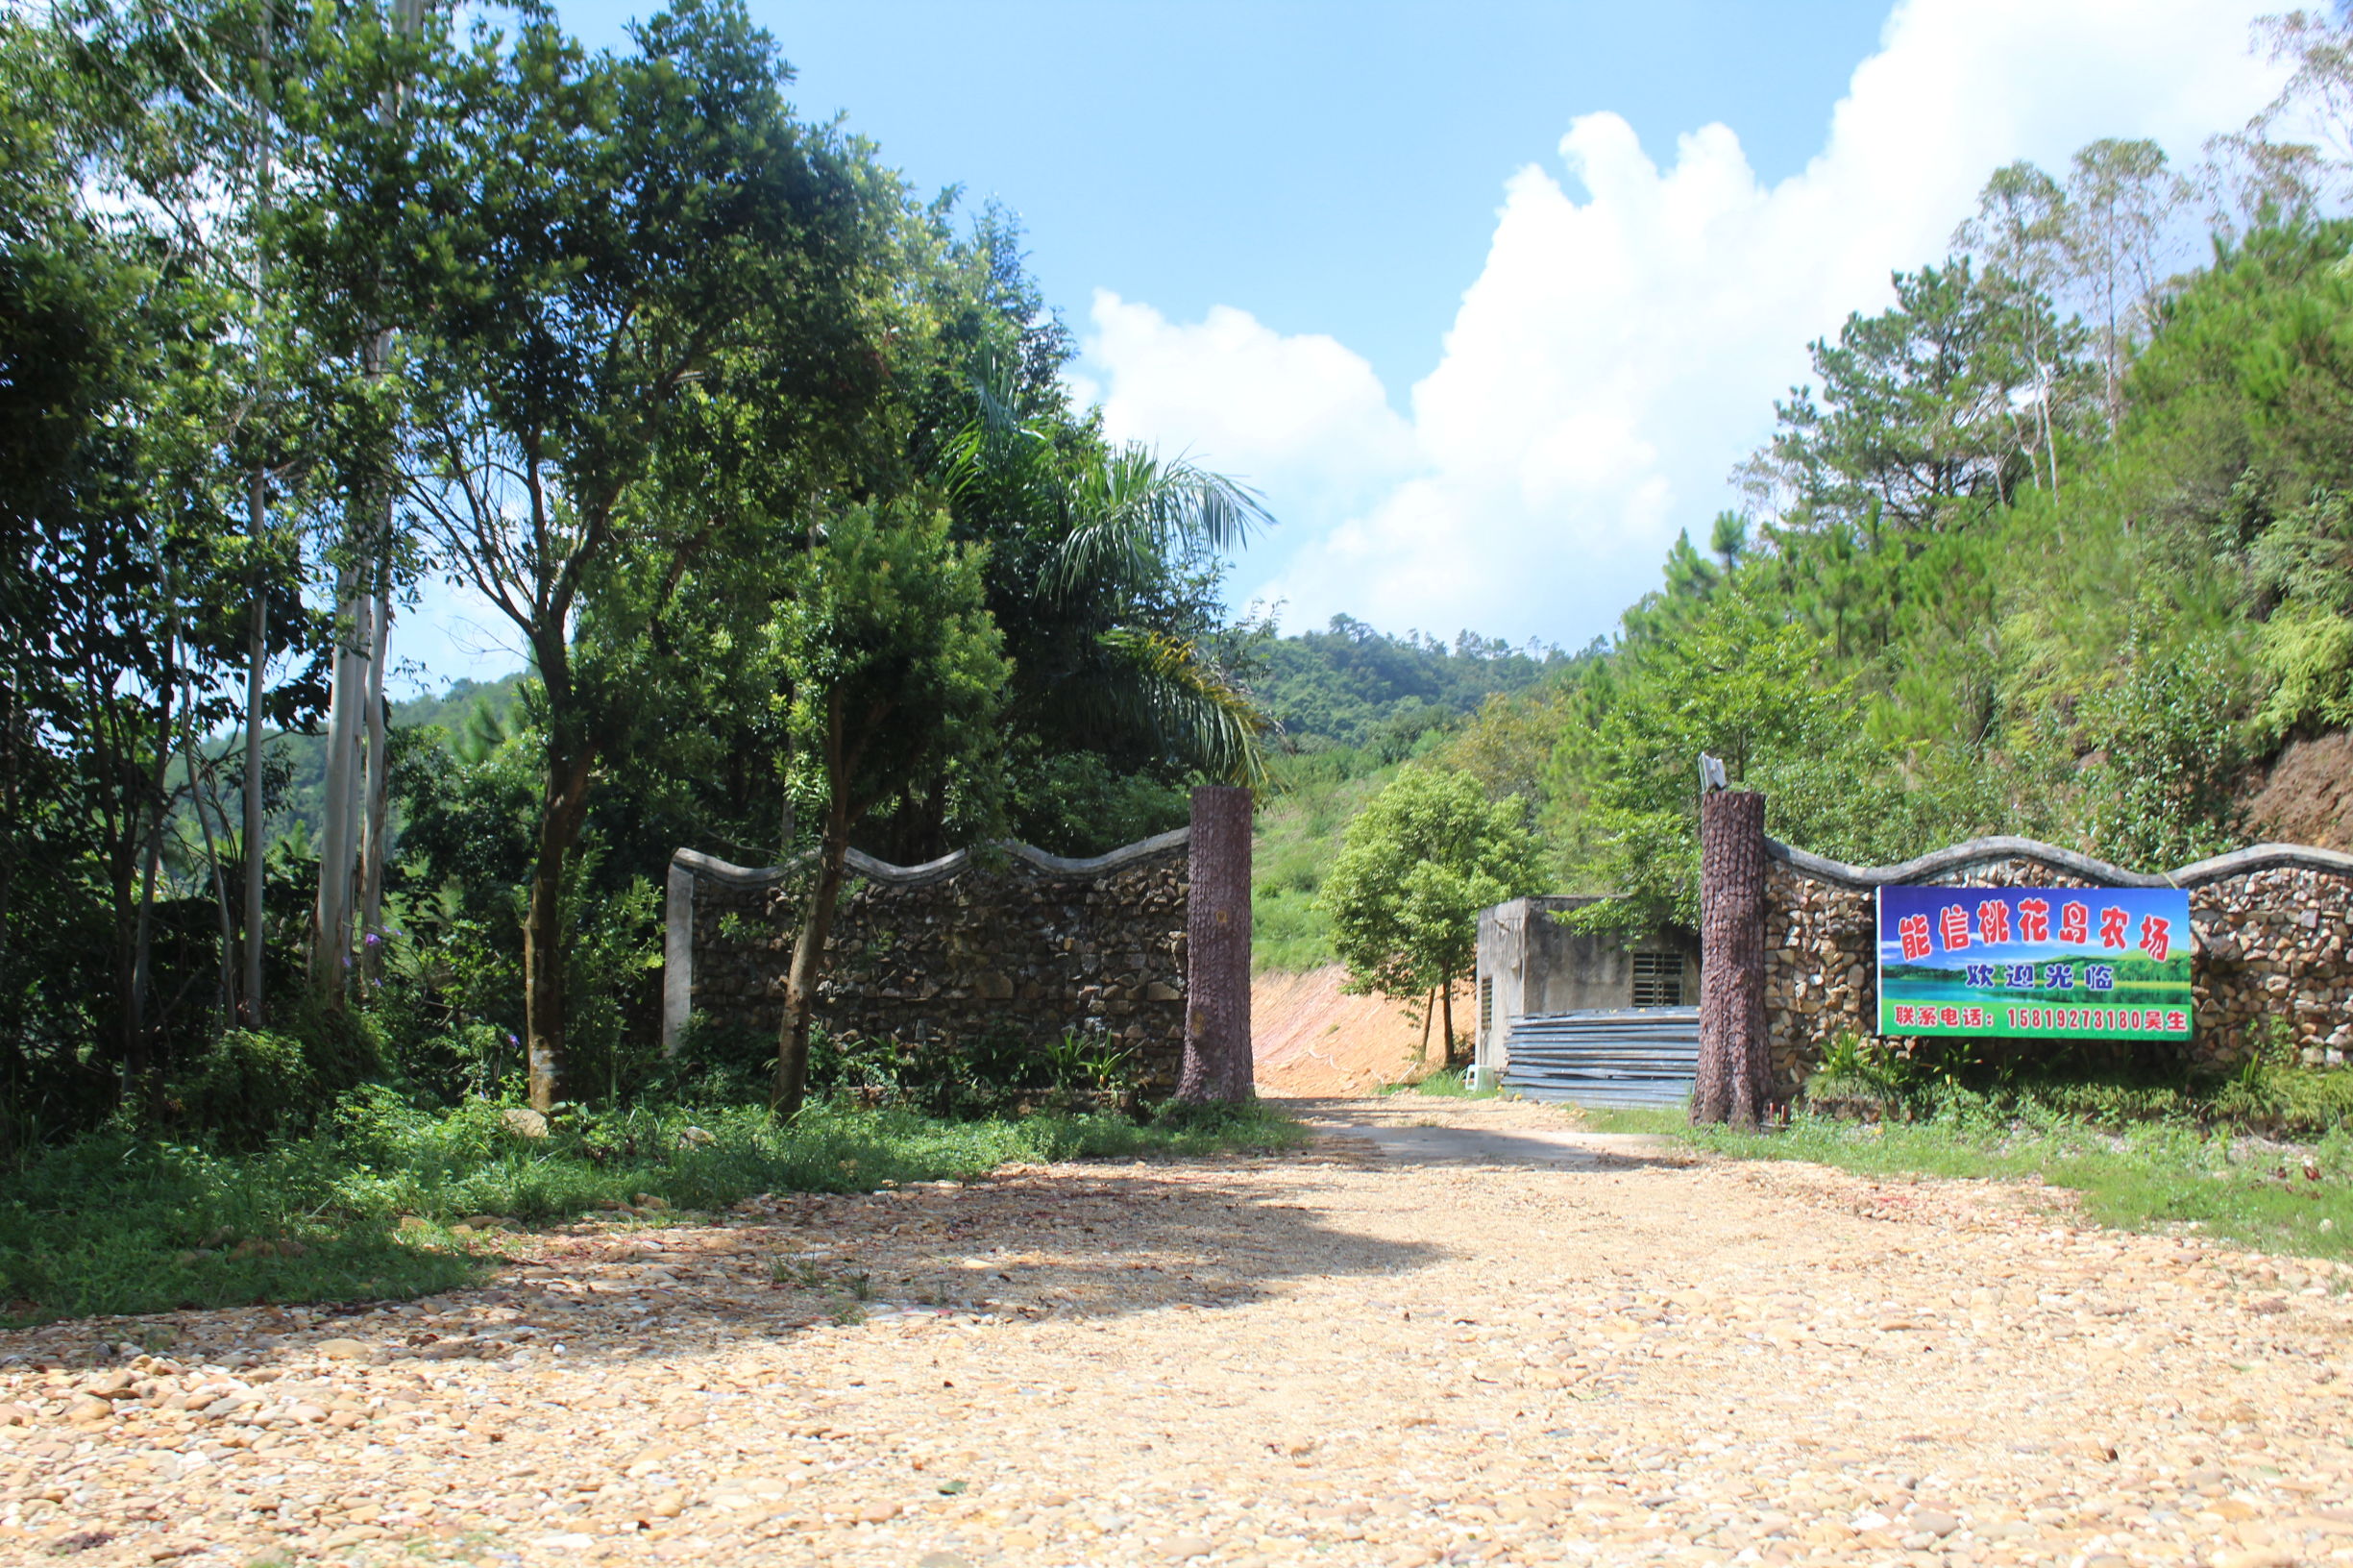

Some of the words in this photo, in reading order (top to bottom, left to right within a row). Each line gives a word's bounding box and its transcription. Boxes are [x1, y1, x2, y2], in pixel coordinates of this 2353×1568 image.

[1899, 897, 2170, 962] 能信桃花岛农场
[1966, 964, 2113, 990] 欢迎光临
